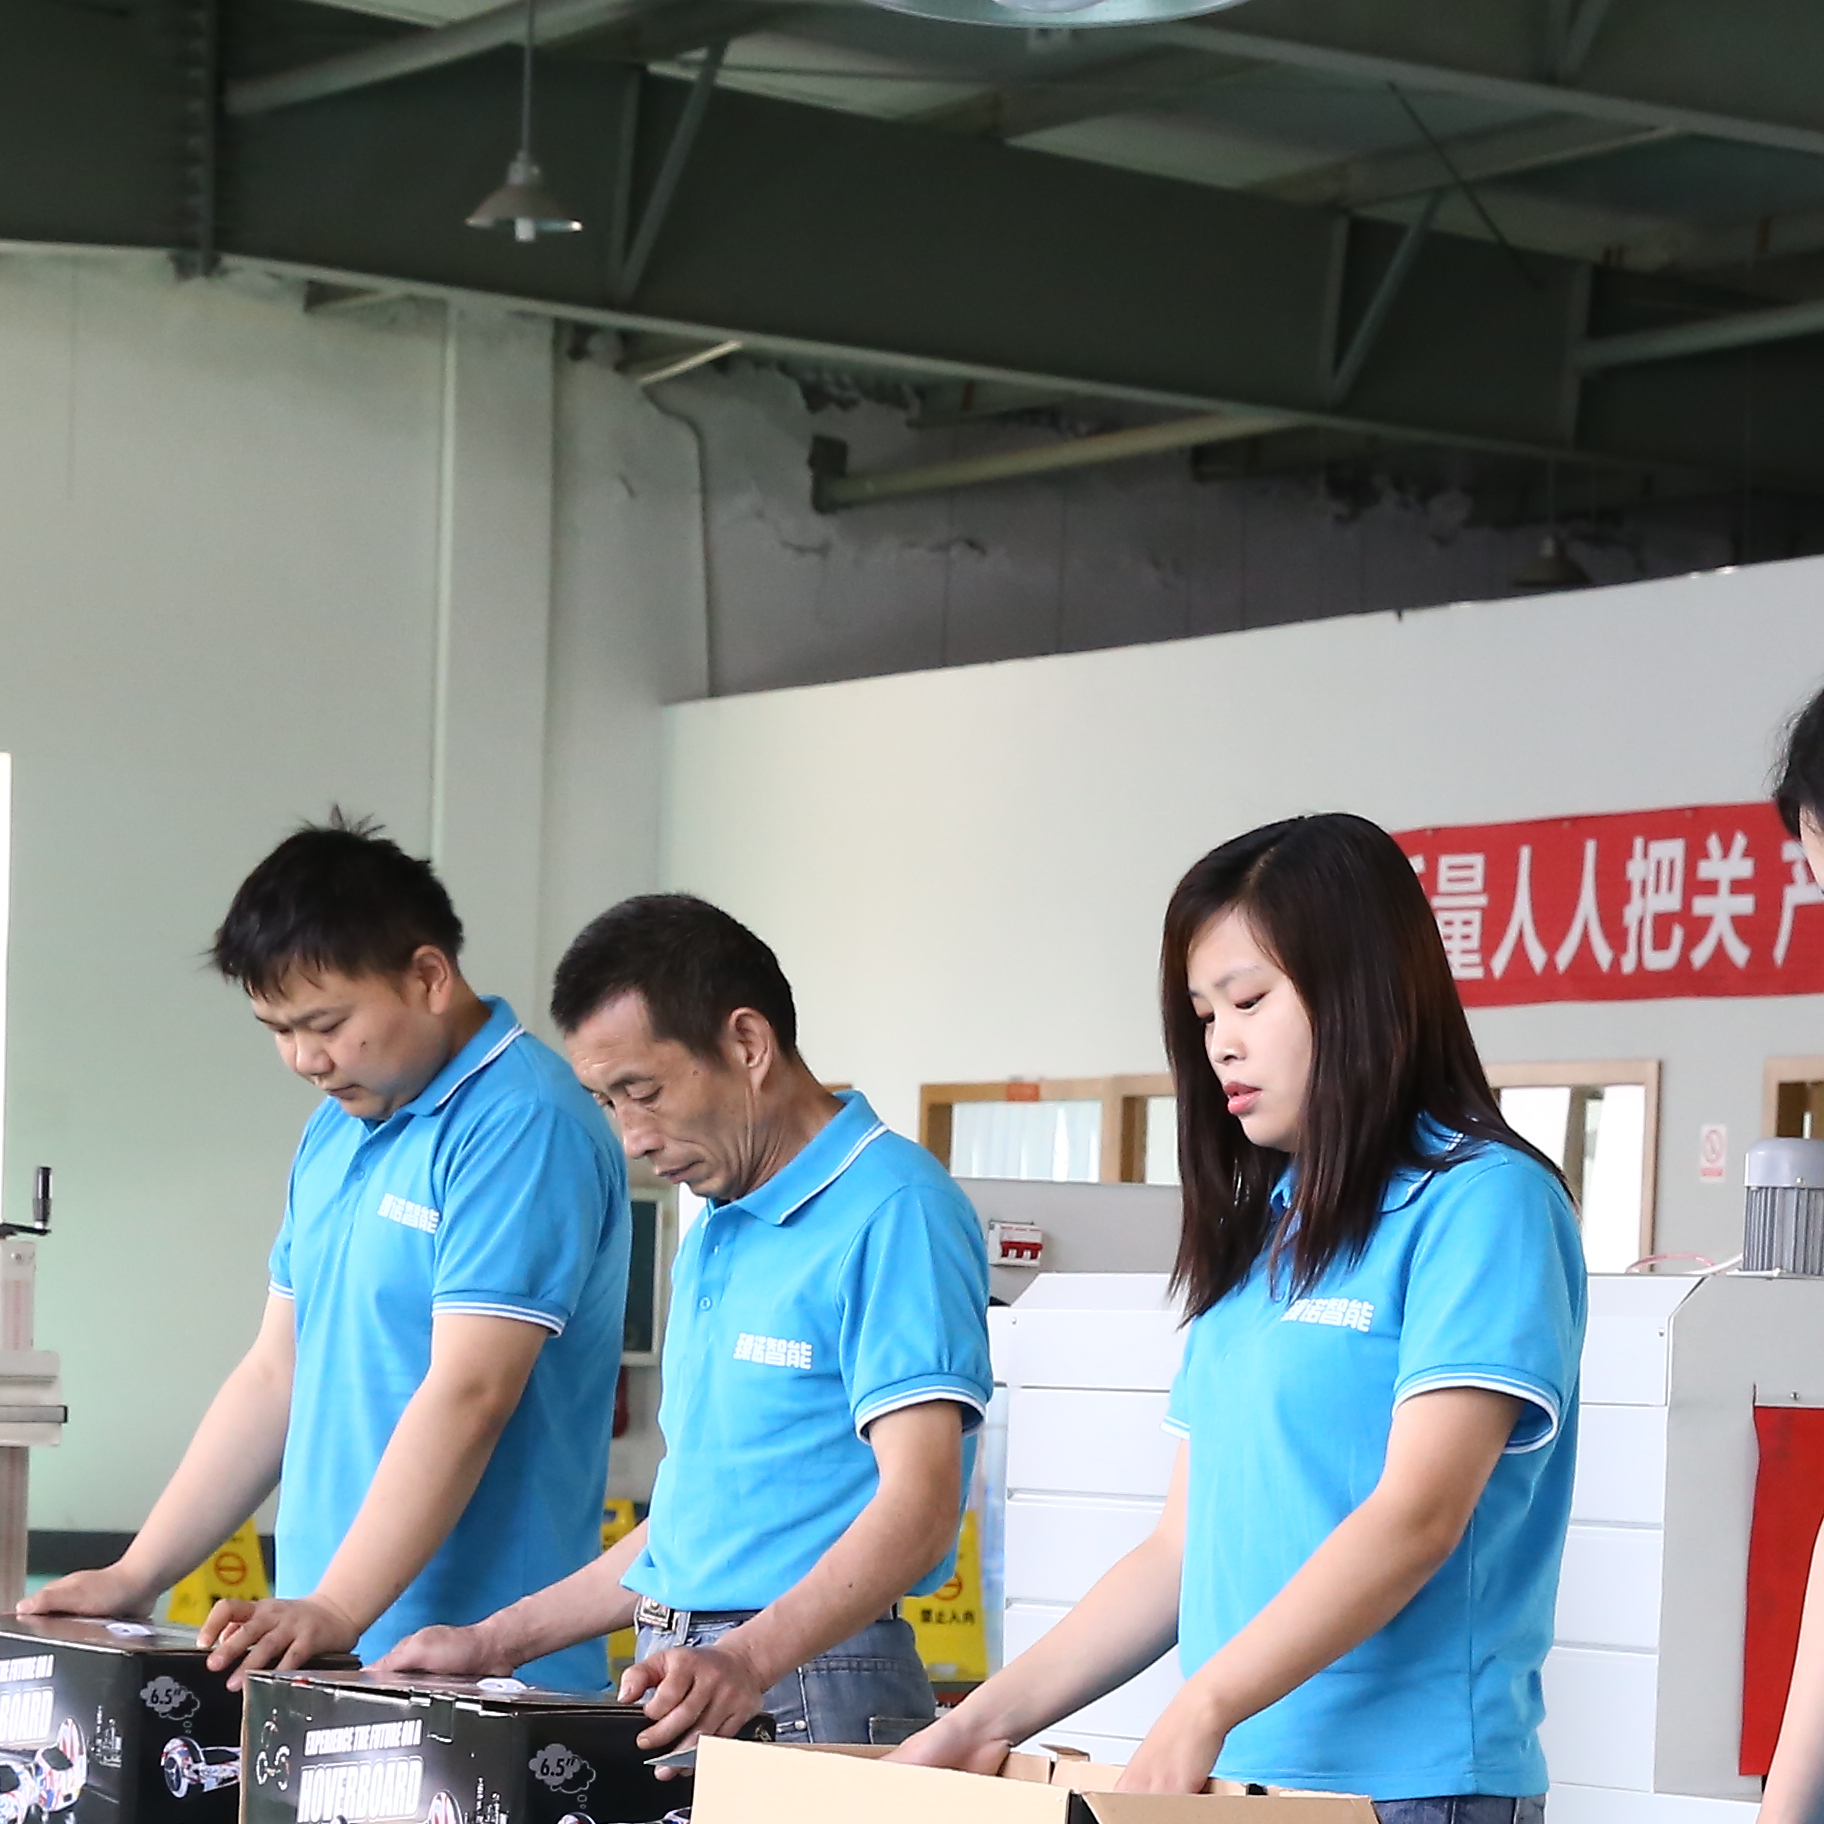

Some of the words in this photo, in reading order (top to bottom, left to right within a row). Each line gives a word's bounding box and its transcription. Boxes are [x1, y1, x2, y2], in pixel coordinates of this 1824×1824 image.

[1412, 830, 1756, 979] 量人人把关
[304, 1727, 355, 1755] EXPERIENCE
